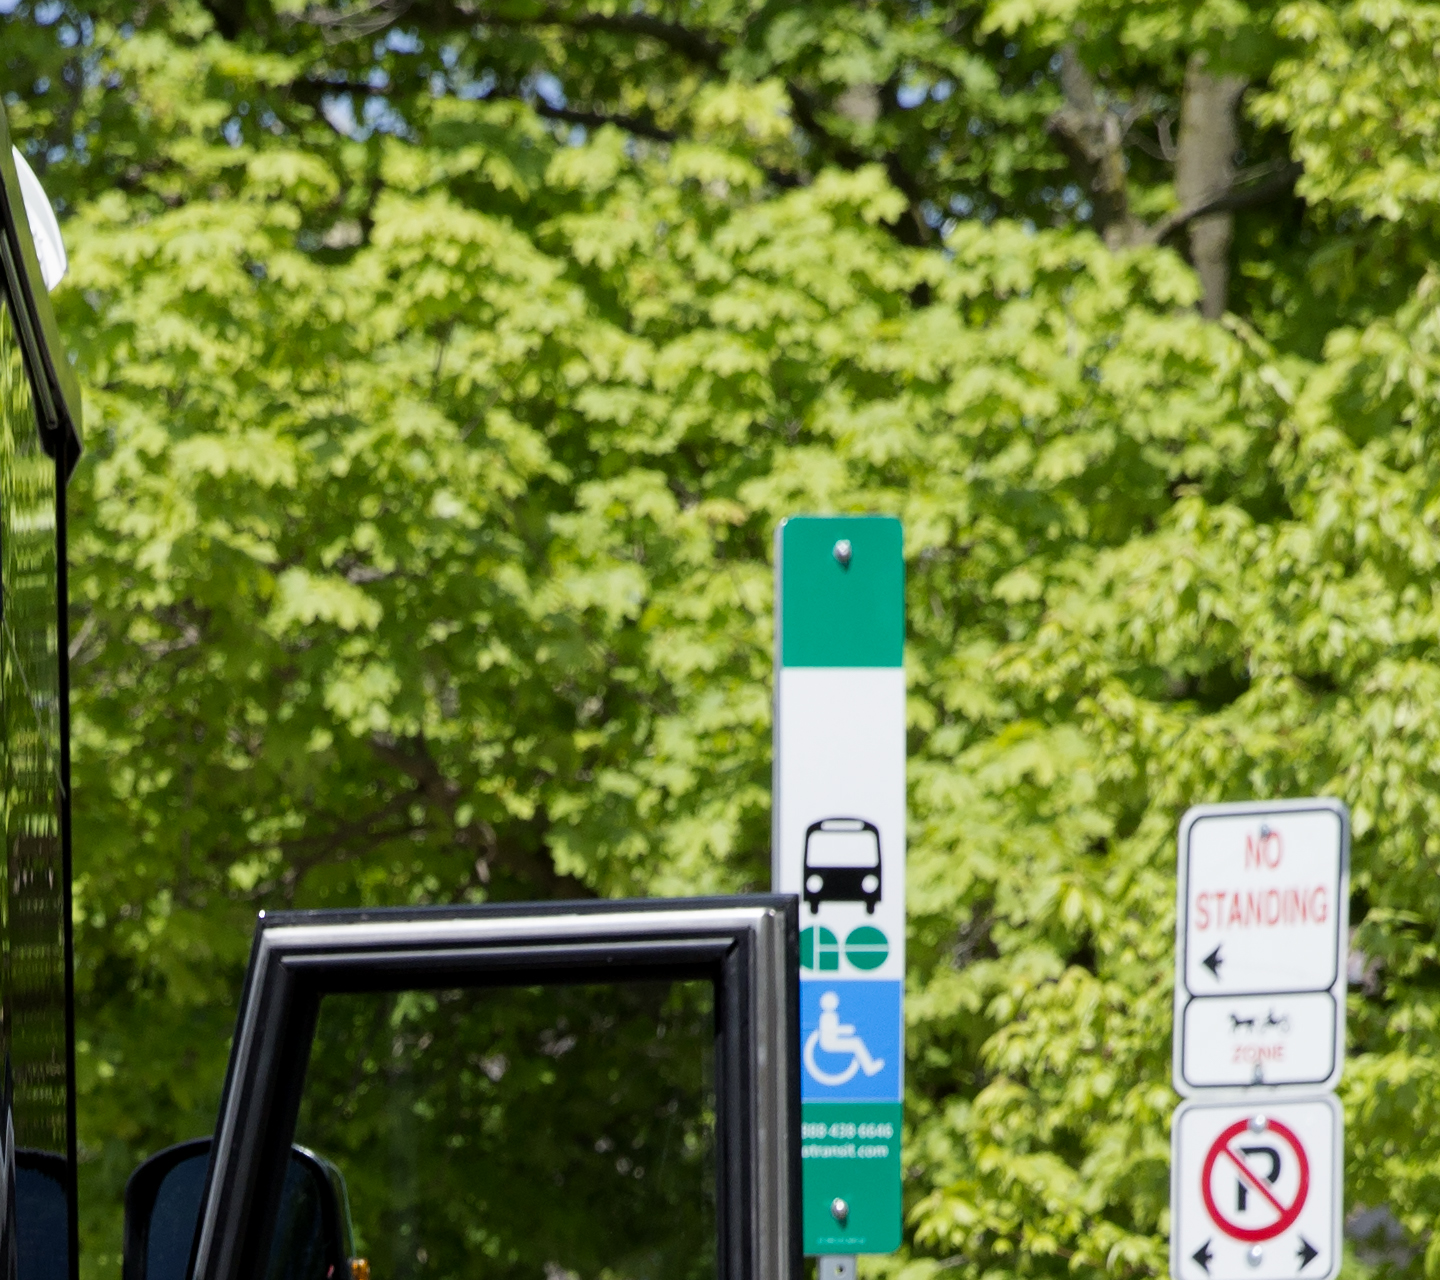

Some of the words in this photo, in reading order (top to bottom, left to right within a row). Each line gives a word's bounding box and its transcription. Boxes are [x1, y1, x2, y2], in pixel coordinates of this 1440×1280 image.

[1245, 830, 1284, 870] NO
[1195, 885, 1327, 931] STANDING
[801, 1142, 889, 1158] otransit.com
